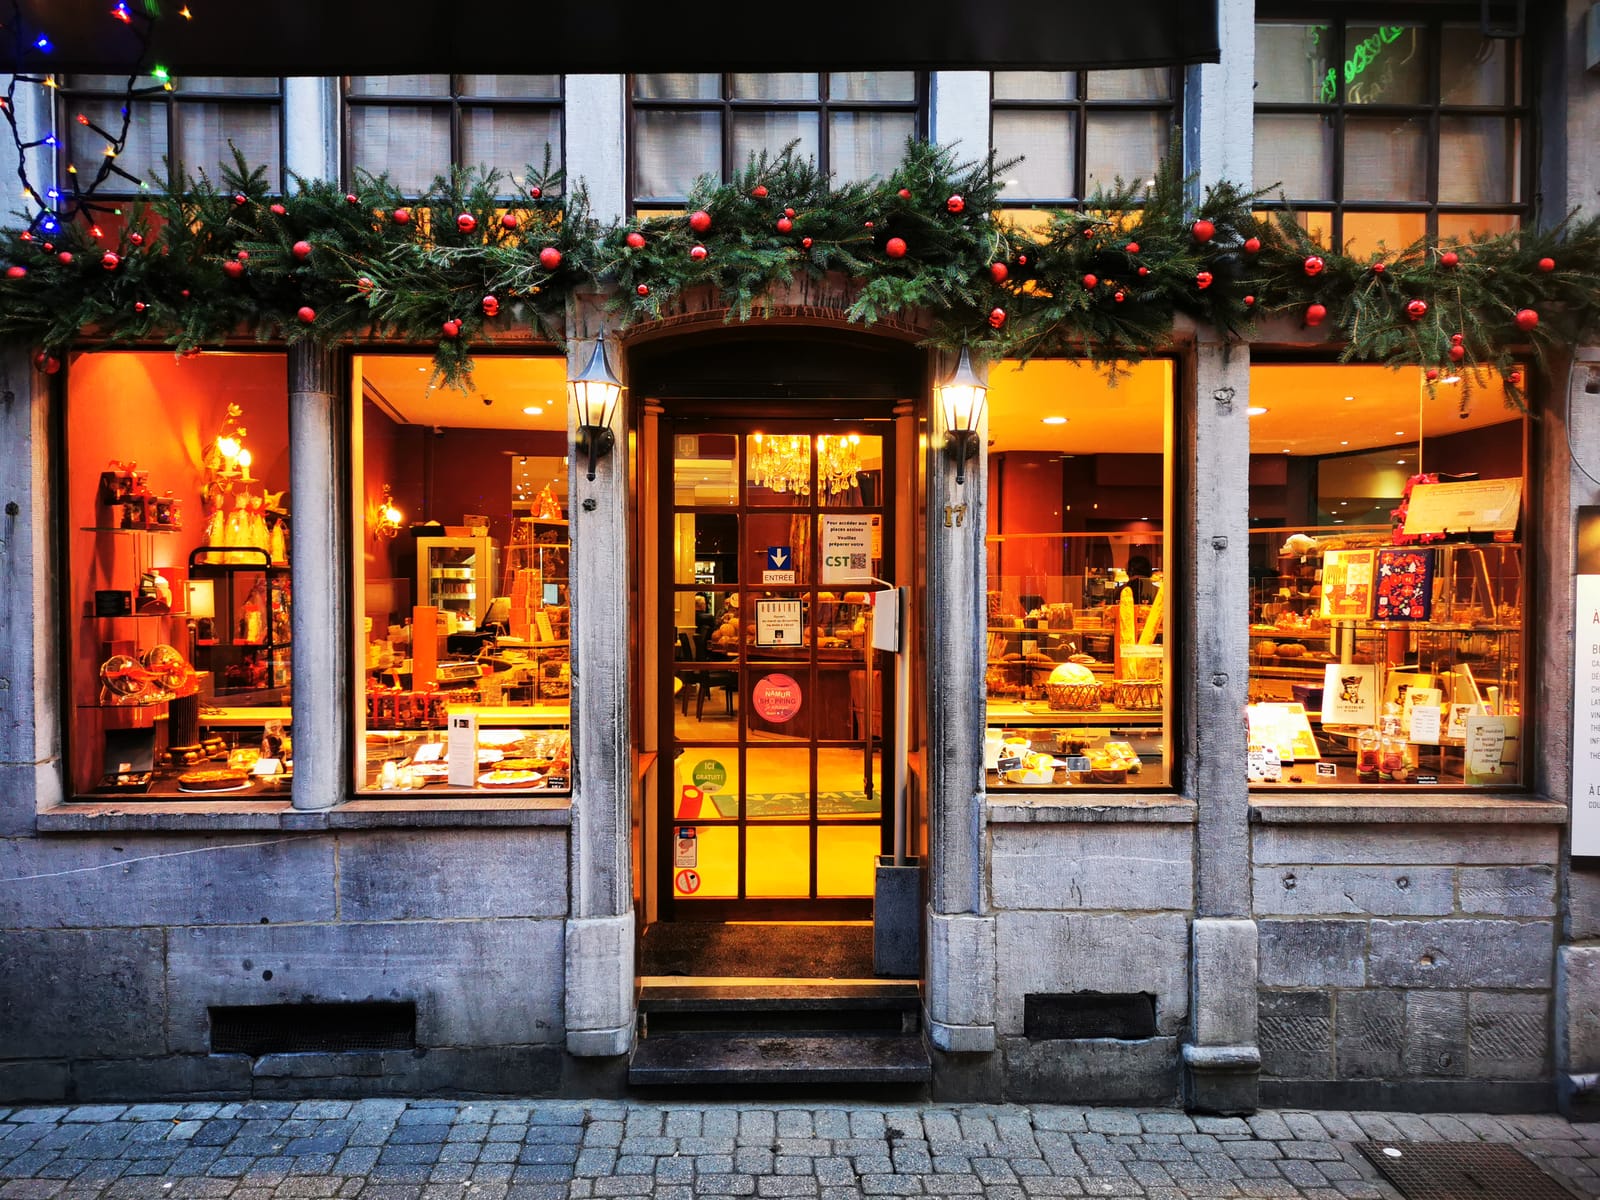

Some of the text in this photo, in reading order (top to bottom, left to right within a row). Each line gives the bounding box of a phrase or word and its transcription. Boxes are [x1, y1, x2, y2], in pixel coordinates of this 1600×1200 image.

[944, 503, 967, 527] 17
[825, 556, 850, 567] CST
[764, 573, 794, 581] ENTRÉE
[765, 690, 791, 698] NAMUR
[704, 761, 715, 770] ICI
